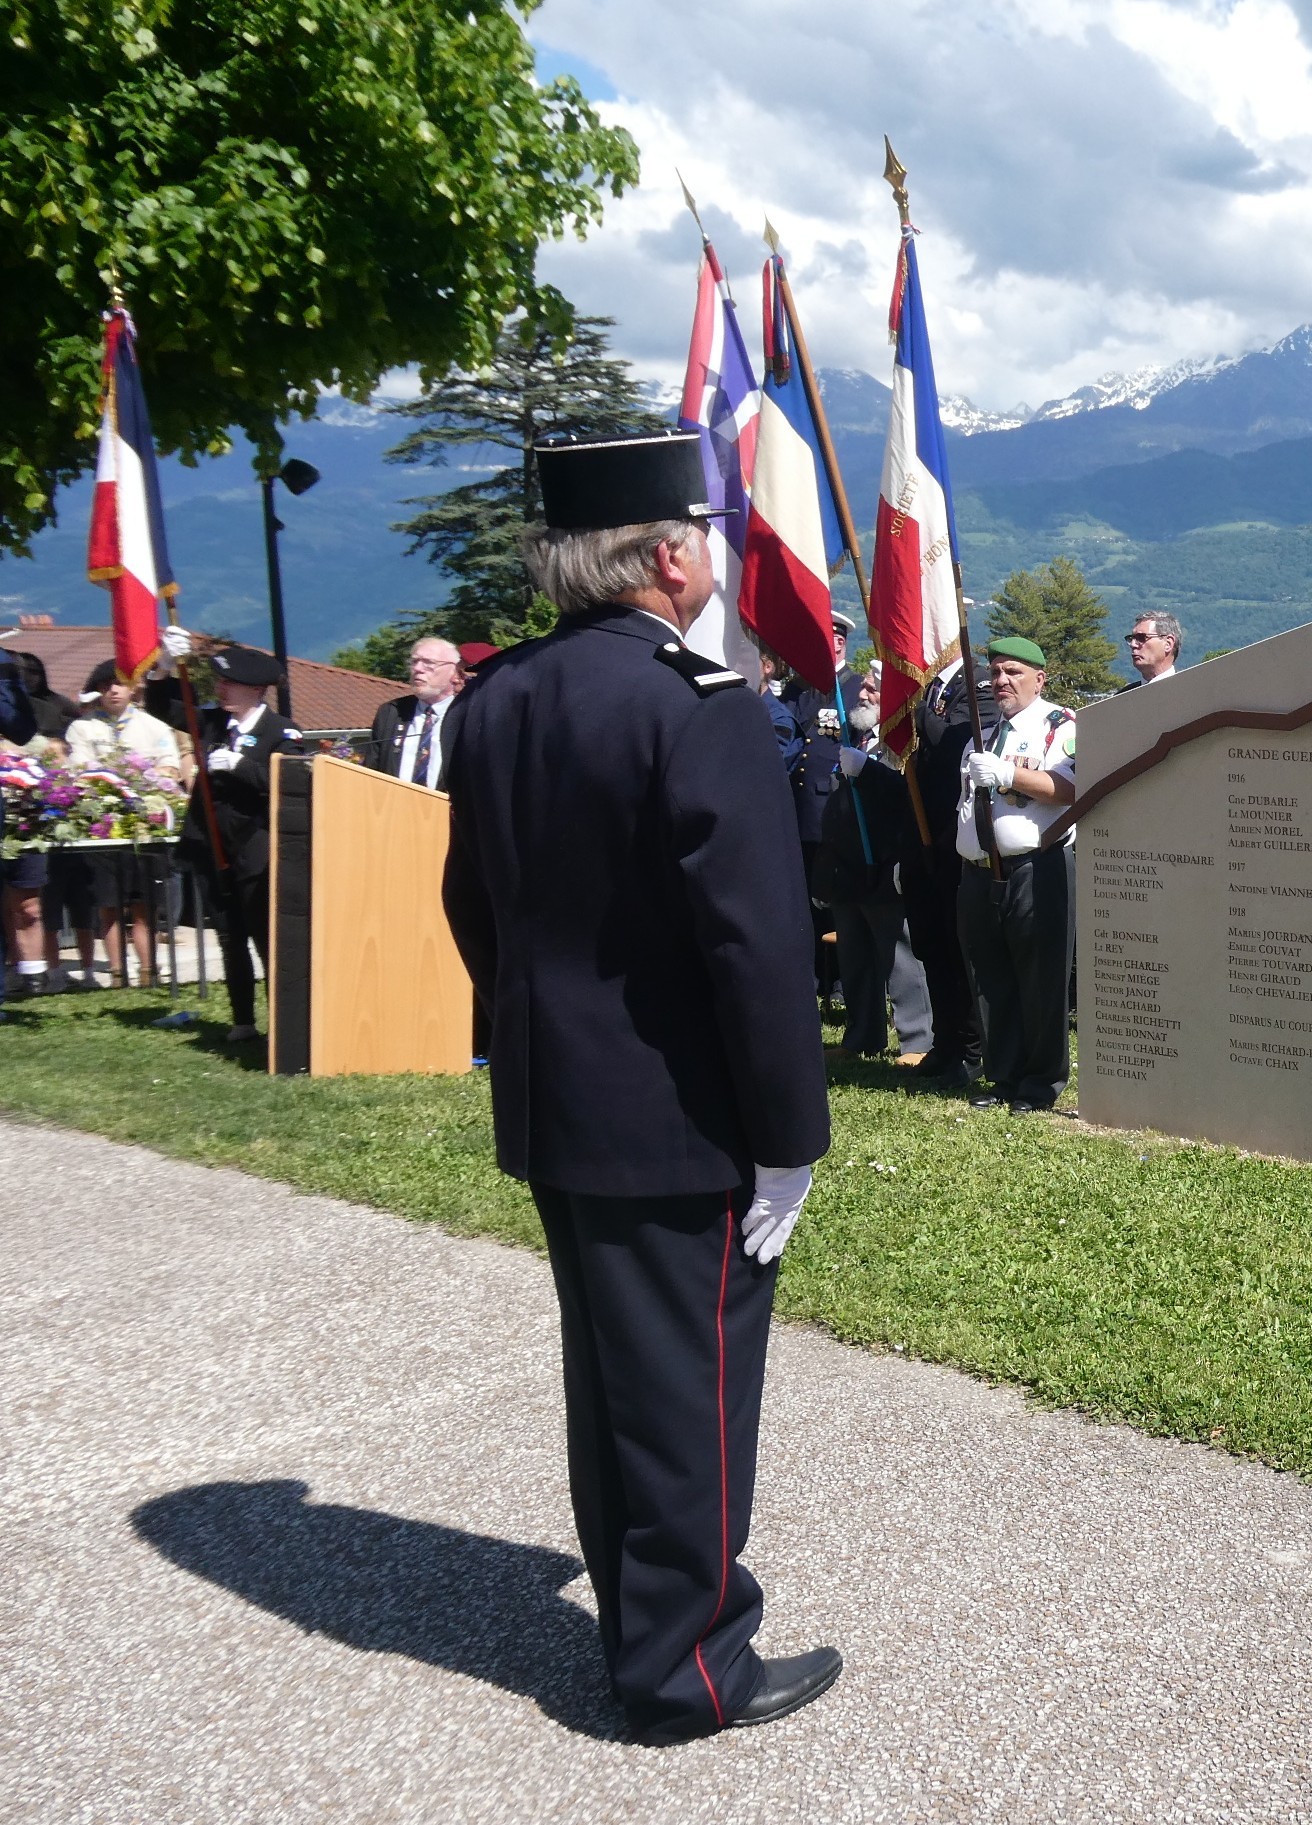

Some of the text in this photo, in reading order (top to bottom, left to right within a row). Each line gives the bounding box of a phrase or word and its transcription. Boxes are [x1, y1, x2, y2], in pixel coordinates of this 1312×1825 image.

[1228, 748, 1279, 760] GRANDE
[1228, 774, 1245, 783] 1916
[1248, 796, 1298, 807] DUBARLE
[1228, 809, 1292, 821] Lt MOUNIER
[1093, 829, 1109, 838] 1914
[1264, 826, 1303, 837] MOREL
[1110, 849, 1215, 866] ROUSSE-LACORDAIRE
[1126, 864, 1157, 875] CHAIX
[1228, 862, 1245, 871] 1917
[1124, 878, 1164, 889] MARTIN
[1120, 891, 1148, 902] MURE
[1094, 909, 1110, 918] 1915
[1229, 906, 1246, 917] 1918
[1112, 930, 1159, 944] BONNIER
[1262, 930, 1312, 944] JOURDAN
[1105, 944, 1124, 954] REY
[1258, 944, 1301, 958] COUVAT
[1124, 960, 1169, 973] CHARLES
[1262, 959, 1312, 973] TOUVARD
[1260, 973, 1301, 986] GIRAUD
[1125, 987, 1158, 999] JANOT
[1120, 1000, 1161, 1013] ACHARD
[1133, 1015, 1181, 1030] RICHETTI
[1229, 1013, 1272, 1028] DISPARUS
[1274, 1019, 1286, 1029] AU
[1125, 1027, 1167, 1042] BONNAT
[1133, 1043, 1179, 1058] CHARLES
[1118, 1055, 1155, 1069] FILEPPI
[1265, 1058, 1299, 1071] CHAIX
[1116, 1068, 1147, 1081] CHAIX
